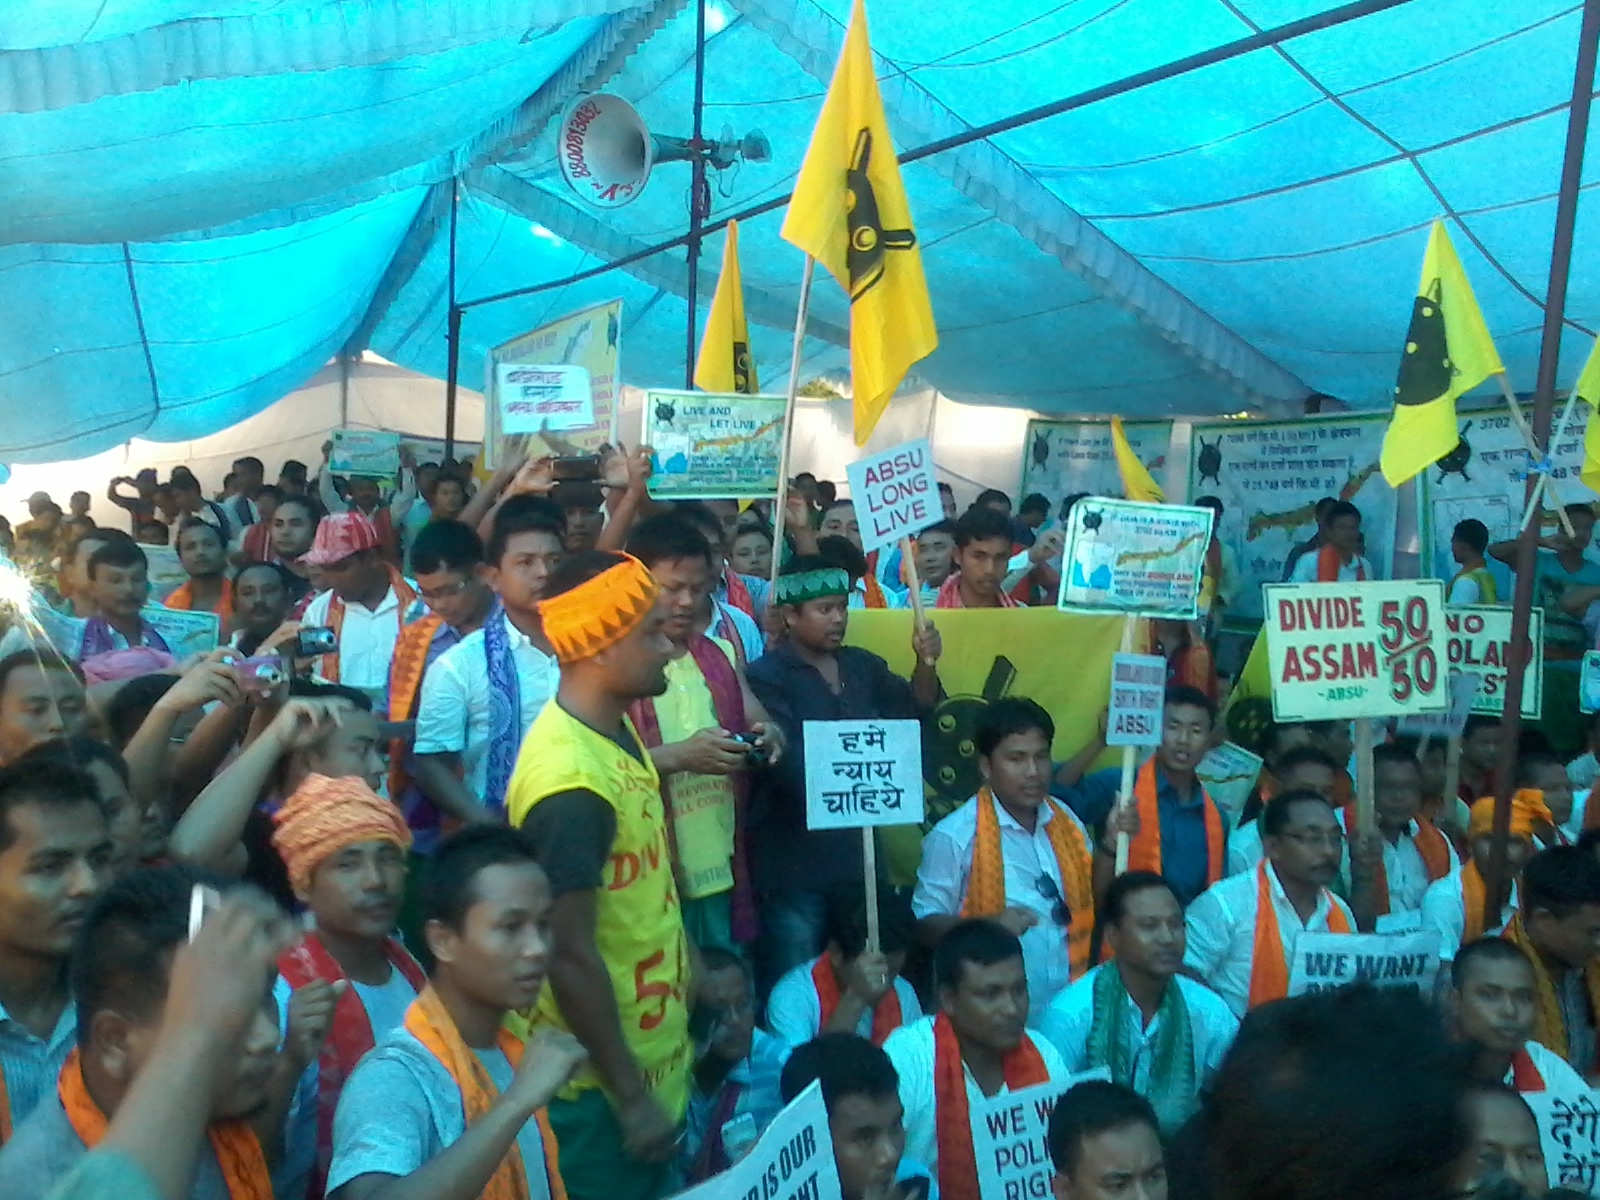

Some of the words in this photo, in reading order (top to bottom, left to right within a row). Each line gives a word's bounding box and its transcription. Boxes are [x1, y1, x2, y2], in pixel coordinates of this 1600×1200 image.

[683, 406, 706, 416] LIVE
[709, 406, 731, 415] AND
[710, 419, 729, 429] LET
[733, 420, 756, 430] LIVE
[865, 448, 923, 488] ABSU
[867, 473, 928, 512] LONG
[873, 499, 927, 537] LIVE
[1279, 596, 1364, 632] DIVIDE
[1379, 595, 1429, 653] 50
[1447, 614, 1484, 633] NO
[1282, 642, 1378, 683] ASSAM
[1391, 646, 1437, 703] 50
[1115, 714, 1155, 735] ABSU
[832, 760, 896, 781] न्याय
[822, 781, 904, 817] चाहिये
[1305, 953, 1348, 977] WE
[1356, 953, 1429, 980] WANT
[986, 1103, 1027, 1140] WE
[1034, 1096, 1055, 1126] W
[762, 1161, 779, 1200] IS
[779, 1124, 816, 1182] OUR
[995, 1136, 1050, 1177] POLI
